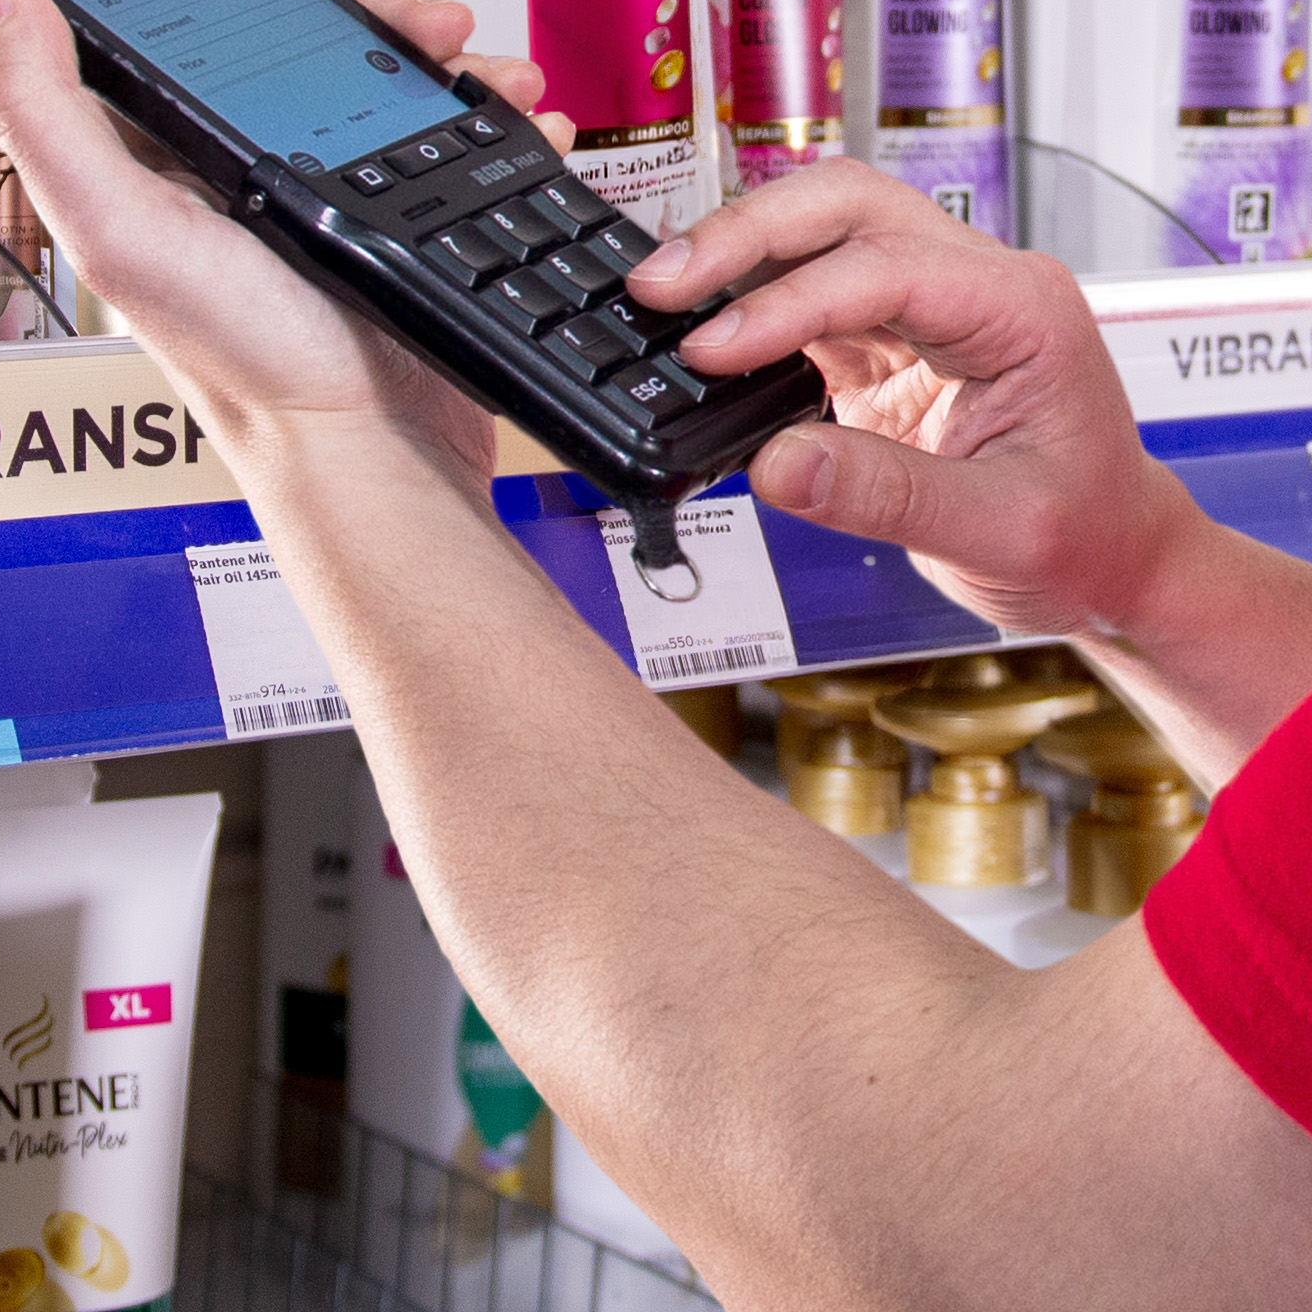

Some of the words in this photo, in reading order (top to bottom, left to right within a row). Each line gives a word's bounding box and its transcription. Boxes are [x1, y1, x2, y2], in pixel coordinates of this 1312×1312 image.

[888, 8, 969, 35] GLOWING
[1191, 8, 1271, 35] GLOWING
[468, 158, 515, 187] RGIS
[515, 150, 546, 171] RM3
[441, 234, 461, 255] 7
[493, 211, 515, 231] 8
[546, 188, 567, 207] 9
[502, 281, 521, 300] 4
[551, 256, 572, 275] 5
[603, 231, 623, 251] 6
[613, 303, 634, 323] 2
[630, 375, 667, 402] ESC
[189, 555, 246, 571] Pantene
[192, 576, 221, 587] Hair
[224, 570, 244, 583] Oil
[108, 992, 151, 1021] XL
